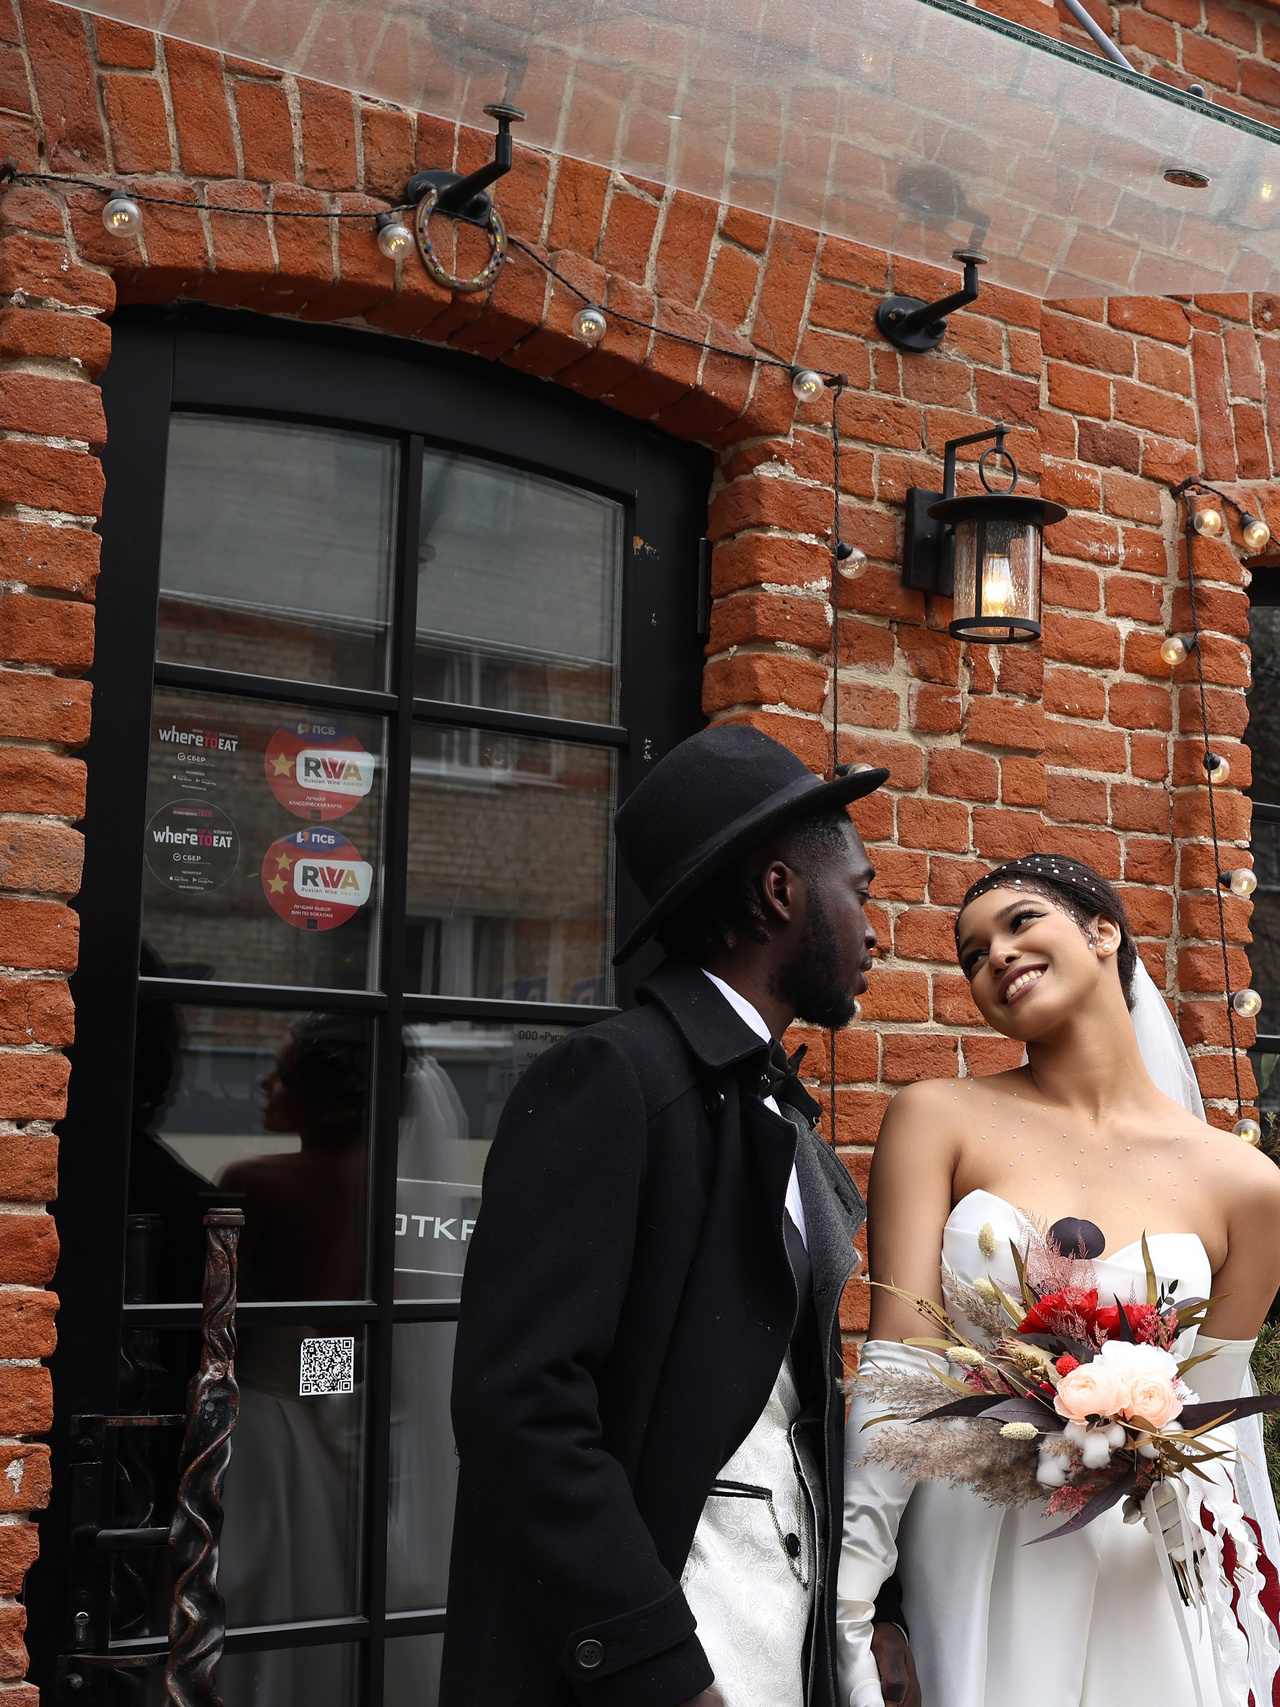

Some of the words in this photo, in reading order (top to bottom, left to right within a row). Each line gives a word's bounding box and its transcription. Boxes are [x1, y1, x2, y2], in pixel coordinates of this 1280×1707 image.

[312, 725, 336, 735] ПСБ
[304, 756, 363, 781] RWA
[312, 833, 335, 845] ПСБ
[301, 865, 360, 891] RWA
[518, 1030, 538, 1041] ООО
